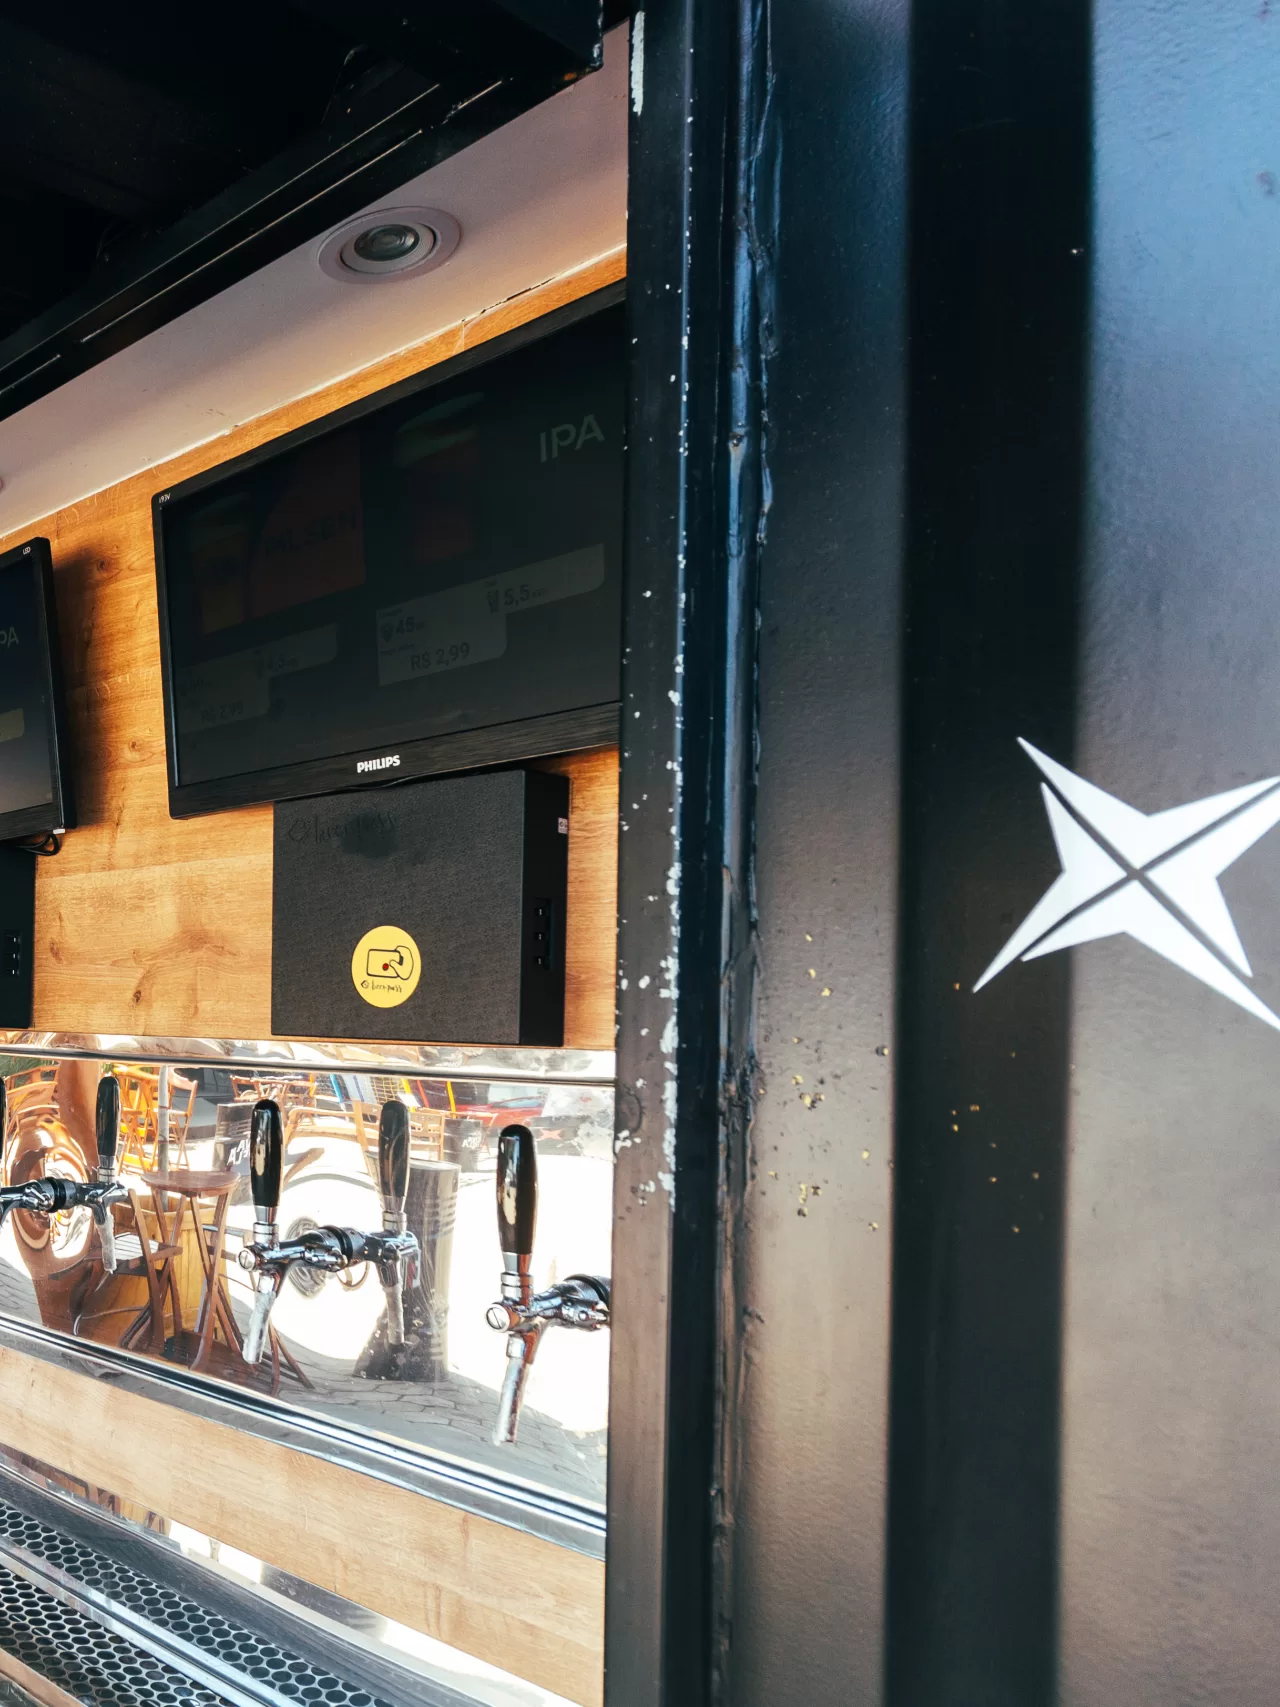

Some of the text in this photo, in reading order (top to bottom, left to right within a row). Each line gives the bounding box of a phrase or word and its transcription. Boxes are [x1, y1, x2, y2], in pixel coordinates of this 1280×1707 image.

[539, 413, 606, 465] IPA
[410, 651, 432, 671] R$
[435, 641, 471, 667] 2,99
[356, 754, 401, 774] PHILIPS
